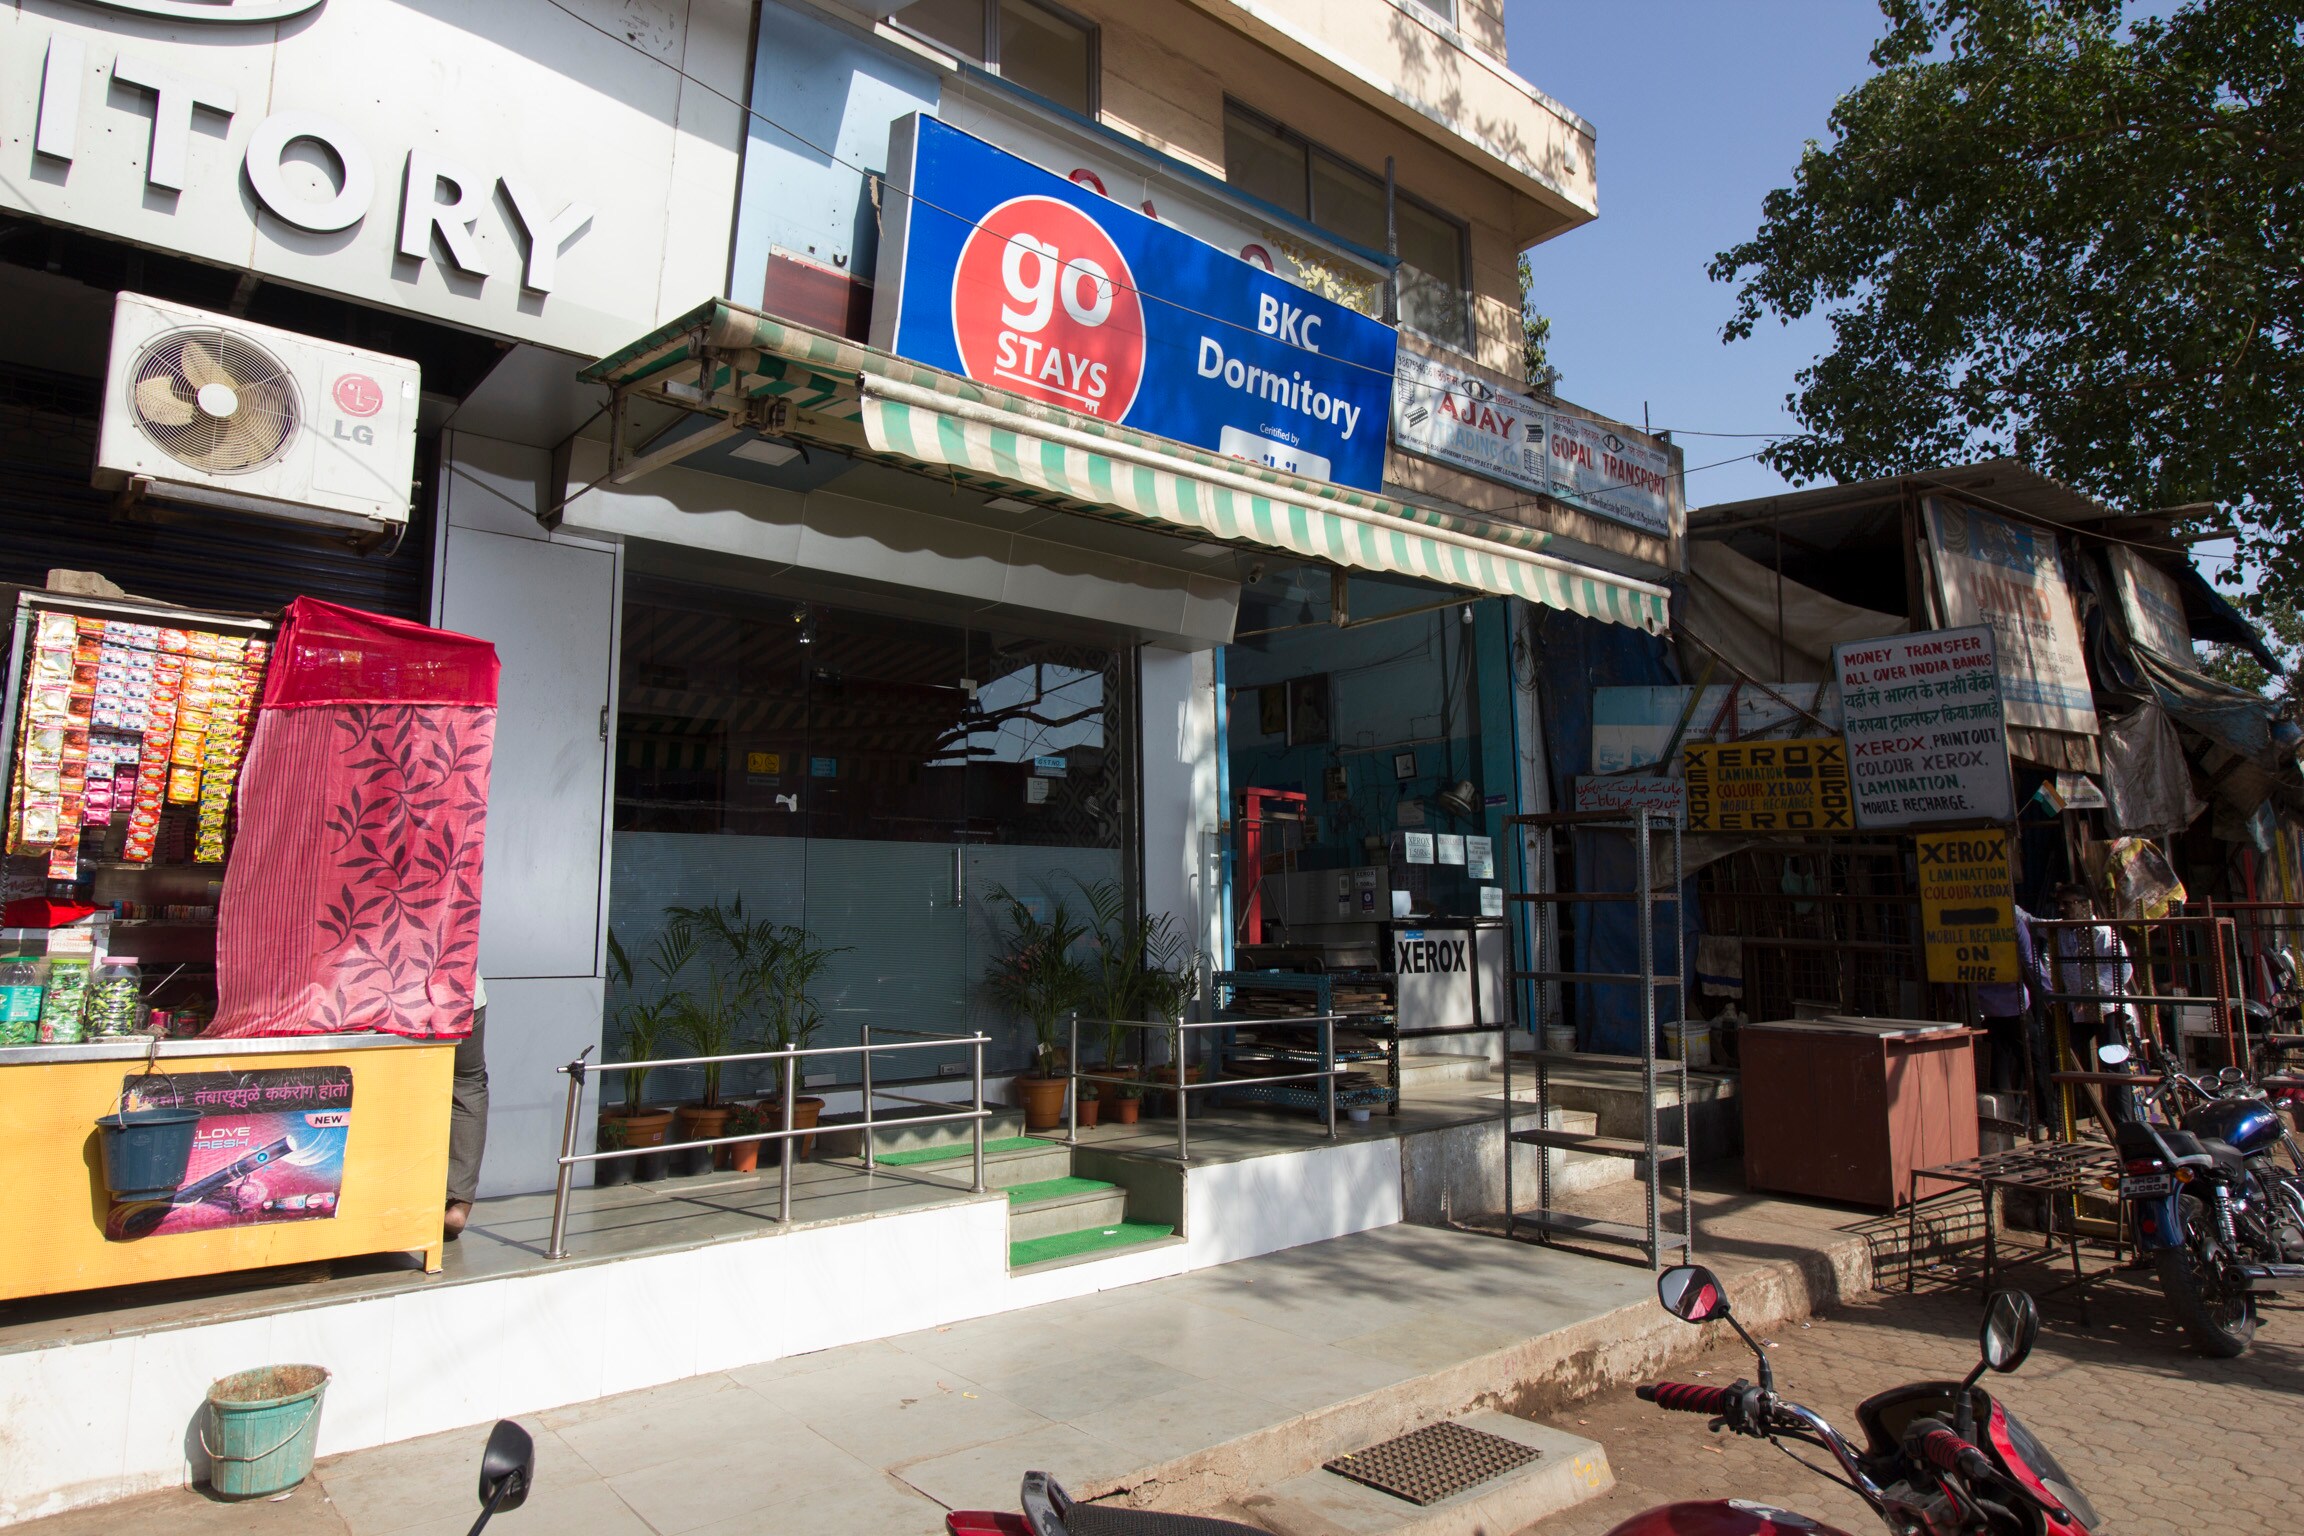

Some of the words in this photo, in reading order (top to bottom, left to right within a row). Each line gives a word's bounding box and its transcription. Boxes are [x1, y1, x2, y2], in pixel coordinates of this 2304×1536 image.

[1001, 233, 1112, 333] go
[1258, 293, 1322, 353] BKC
[996, 331, 1107, 398] STAYS
[1197, 336, 1361, 440] Dormitory
[1437, 391, 1515, 439] AJAY
[334, 420, 374, 446] LG
[1291, 432, 1300, 447] by
[1434, 421, 1498, 459] TRADING
[1551, 434, 1594, 470] GOPAL
[1603, 453, 1666, 497] TRANSPORT
[1970, 572, 2051, 621] UNITED
[1980, 609, 2011, 632] STEEL
[1844, 649, 1892, 667] MONEY
[1904, 637, 1981, 657] TRANSFER
[1845, 673, 1869, 686] ALL
[1873, 665, 1906, 681] OVER
[1909, 660, 1949, 676] INDIA
[1952, 654, 1992, 670] BANKS
[1867, 686, 1881, 706] से
[1884, 685, 1918, 703] भारत
[1918, 679, 1933, 699] के
[1941, 704, 1968, 724] किया
[1968, 702, 1991, 720] जाता
[1990, 694, 1999, 718] है
[1684, 745, 1843, 767] XEROX
[1856, 758, 1914, 777] COLOUR
[1718, 767, 1782, 781] LAMINATION
[1716, 783, 1764, 799] COLOUR
[1766, 782, 1814, 797] XEROX
[1763, 796, 1814, 811] RECHARGE
[1861, 799, 1899, 815] MOBILE
[1690, 810, 1849, 829] XEROX
[1408, 836, 1431, 846] XEROX
[1920, 839, 2006, 864] XEROX
[1929, 867, 2007, 882] LAMINATION
[1924, 885, 1971, 900] COLOUR
[1973, 883, 2010, 898] XEROX
[1926, 929, 1964, 944] MOBILE
[1398, 939, 1467, 974] XEROX
[1956, 945, 1990, 961] ON
[1957, 965, 1996, 981] HIRE
[194, 1083, 261, 1109] तंबाखूमुळे
[265, 1081, 314, 1102] कर्करोग
[319, 1079, 349, 1100] होतो
[314, 1115, 343, 1124] NEW
